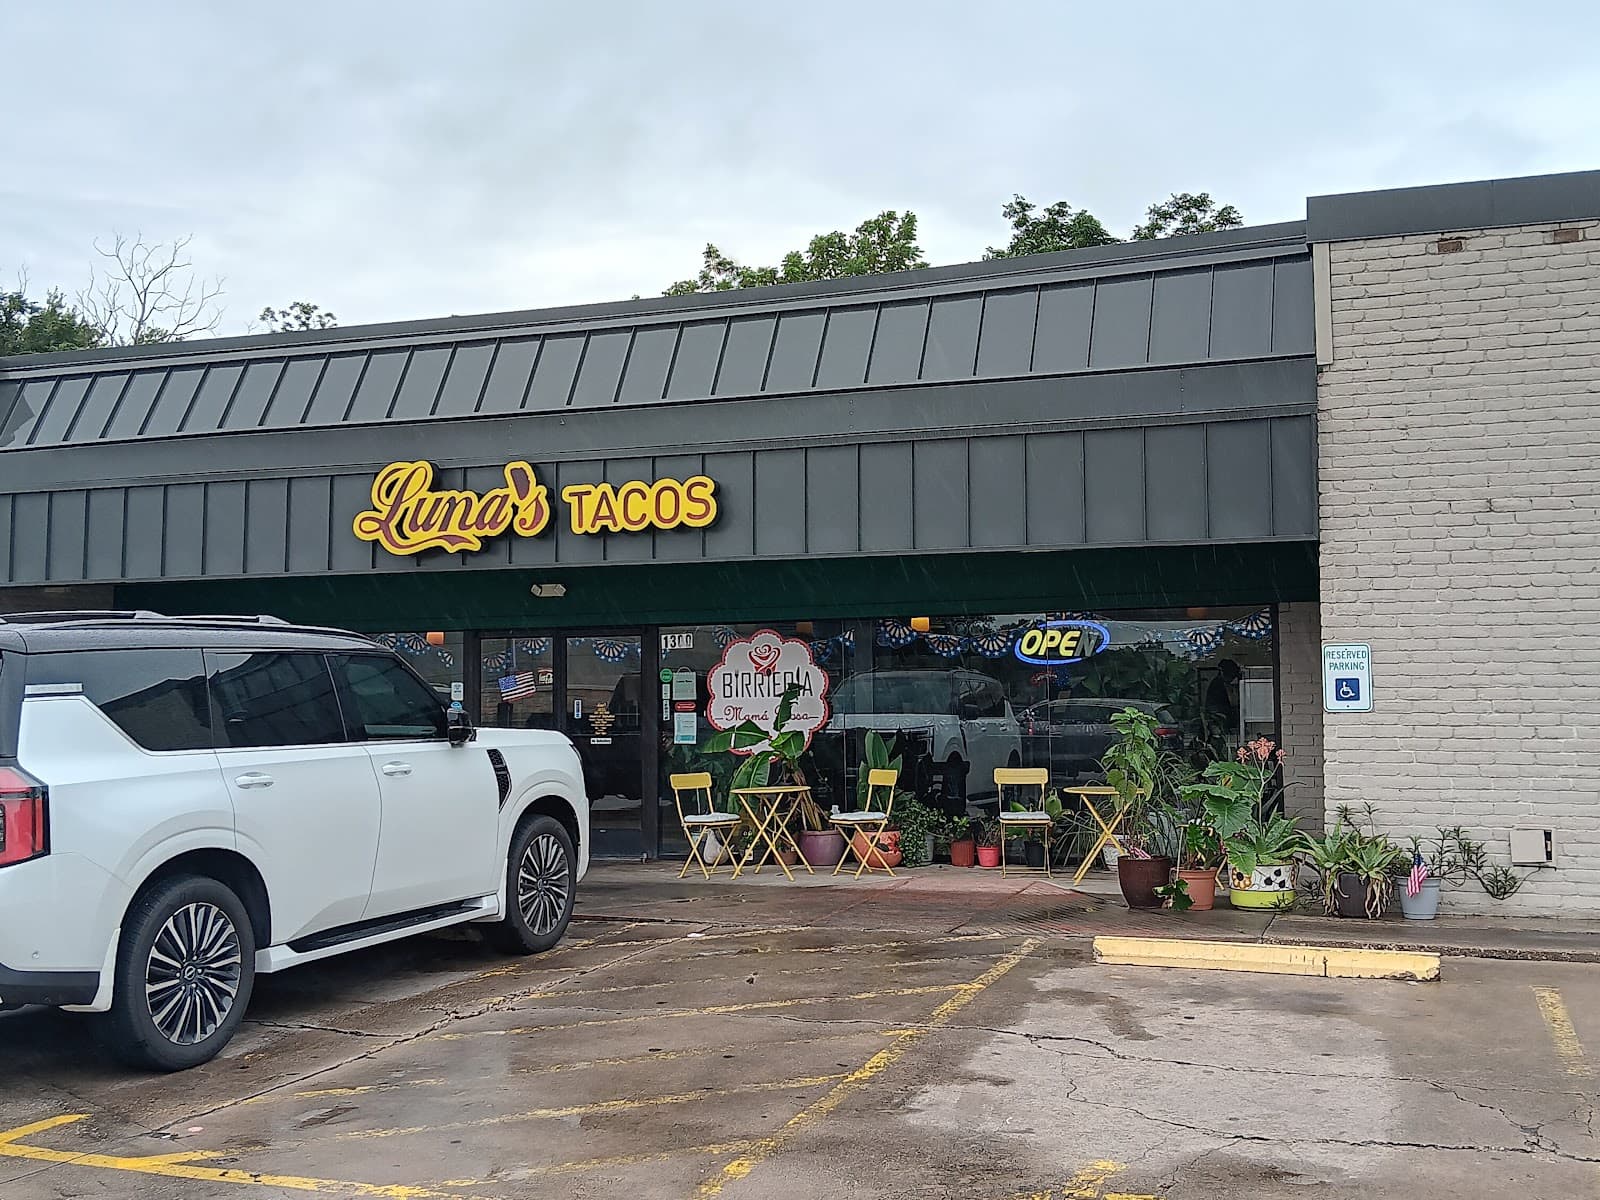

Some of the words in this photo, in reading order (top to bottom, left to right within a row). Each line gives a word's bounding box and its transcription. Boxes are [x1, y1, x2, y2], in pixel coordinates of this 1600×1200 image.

[354, 461, 549, 554] Luna's
[564, 477, 715, 533] TACOS
[1020, 628, 1098, 657] OPEN
[1326, 650, 1367, 660] RESERVED
[1328, 661, 1365, 671] PARKING
[724, 705, 769, 721] Mamá
[775, 705, 809, 721] osa
